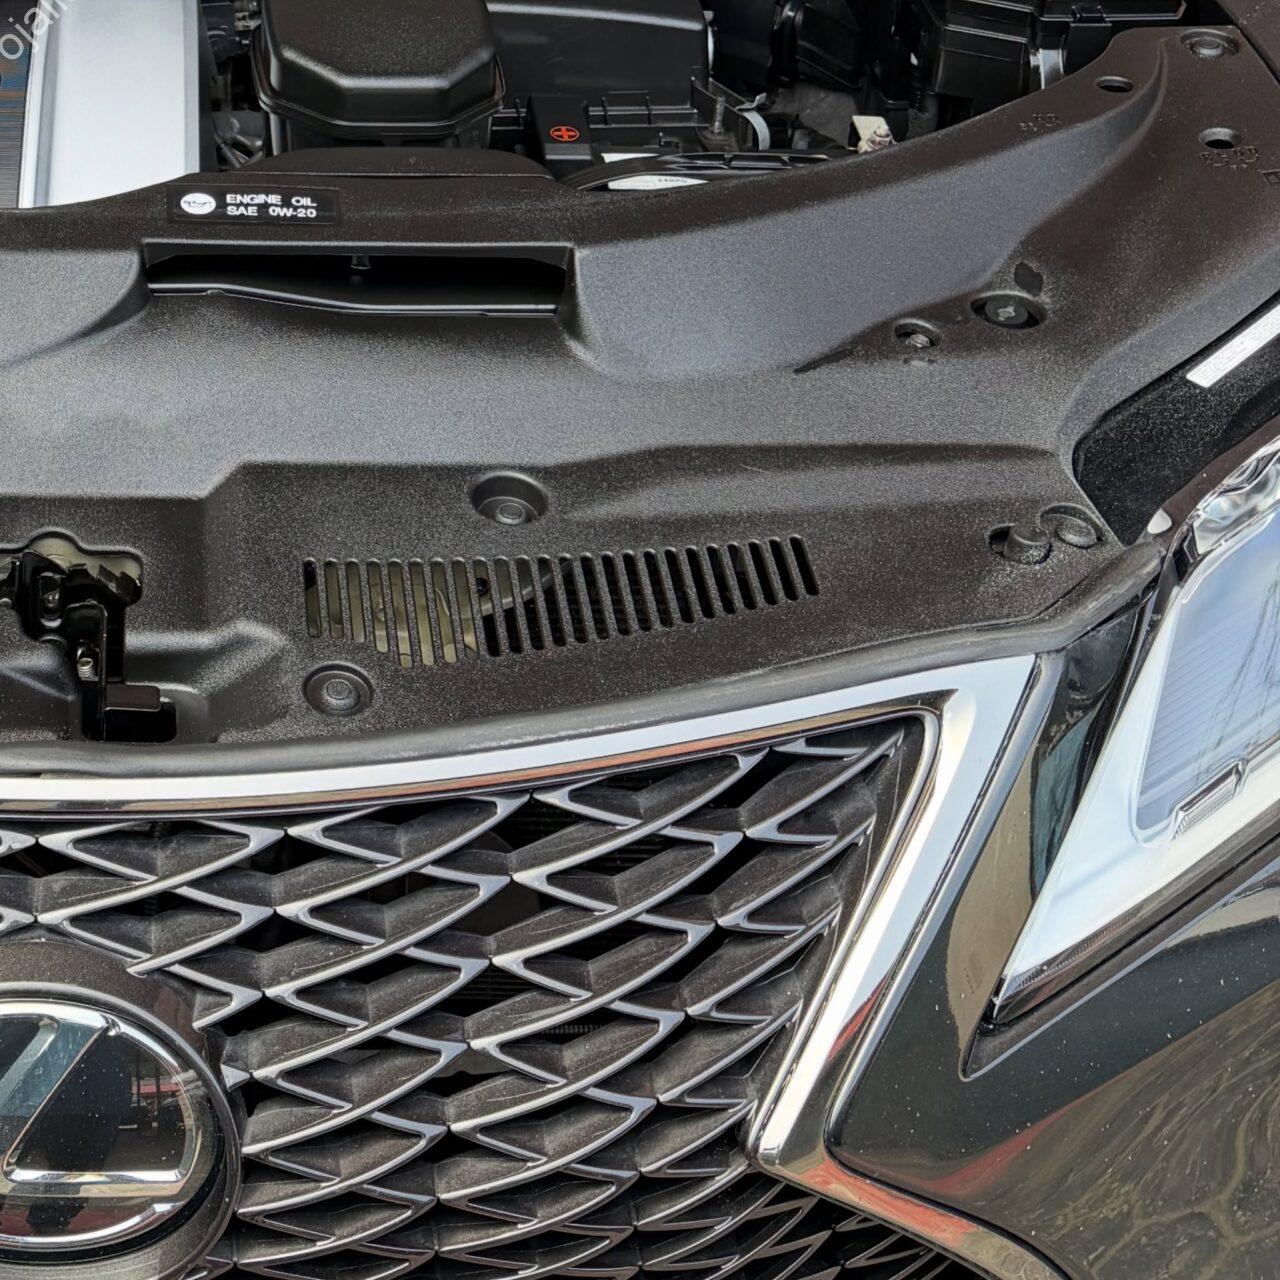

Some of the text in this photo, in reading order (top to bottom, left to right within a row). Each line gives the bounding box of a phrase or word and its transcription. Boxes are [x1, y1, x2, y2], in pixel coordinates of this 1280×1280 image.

[225, 194, 318, 207] ENGINE OIL
[226, 206, 317, 218] SAE 0W-20
